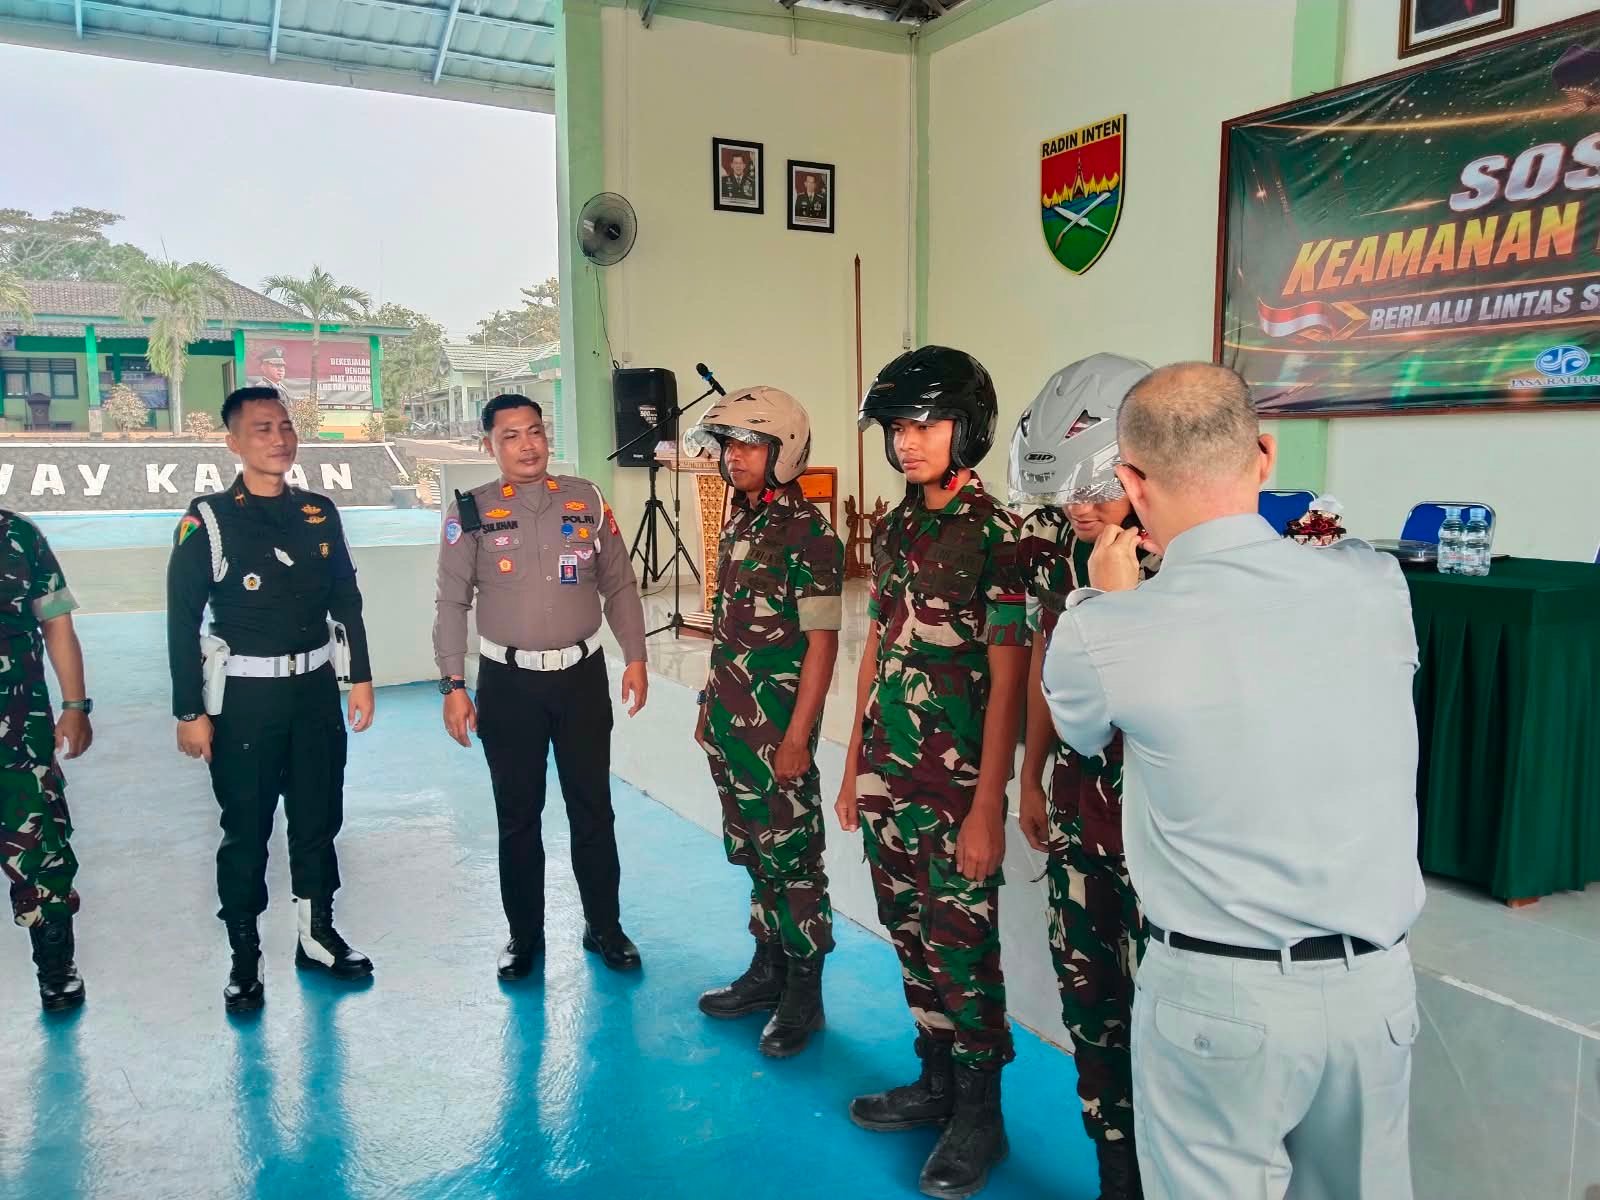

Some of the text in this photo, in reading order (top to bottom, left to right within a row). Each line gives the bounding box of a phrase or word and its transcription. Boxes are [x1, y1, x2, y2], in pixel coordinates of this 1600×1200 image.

[1042, 118, 1121, 158] RADIN INTEN
[1282, 201, 1580, 296] KEAMANAN
[1368, 298, 1473, 332] BERLALU
[1478, 287, 1574, 321] LINTAS
[145, 463, 354, 493] KAAN
[561, 515, 595, 525] POLRI
